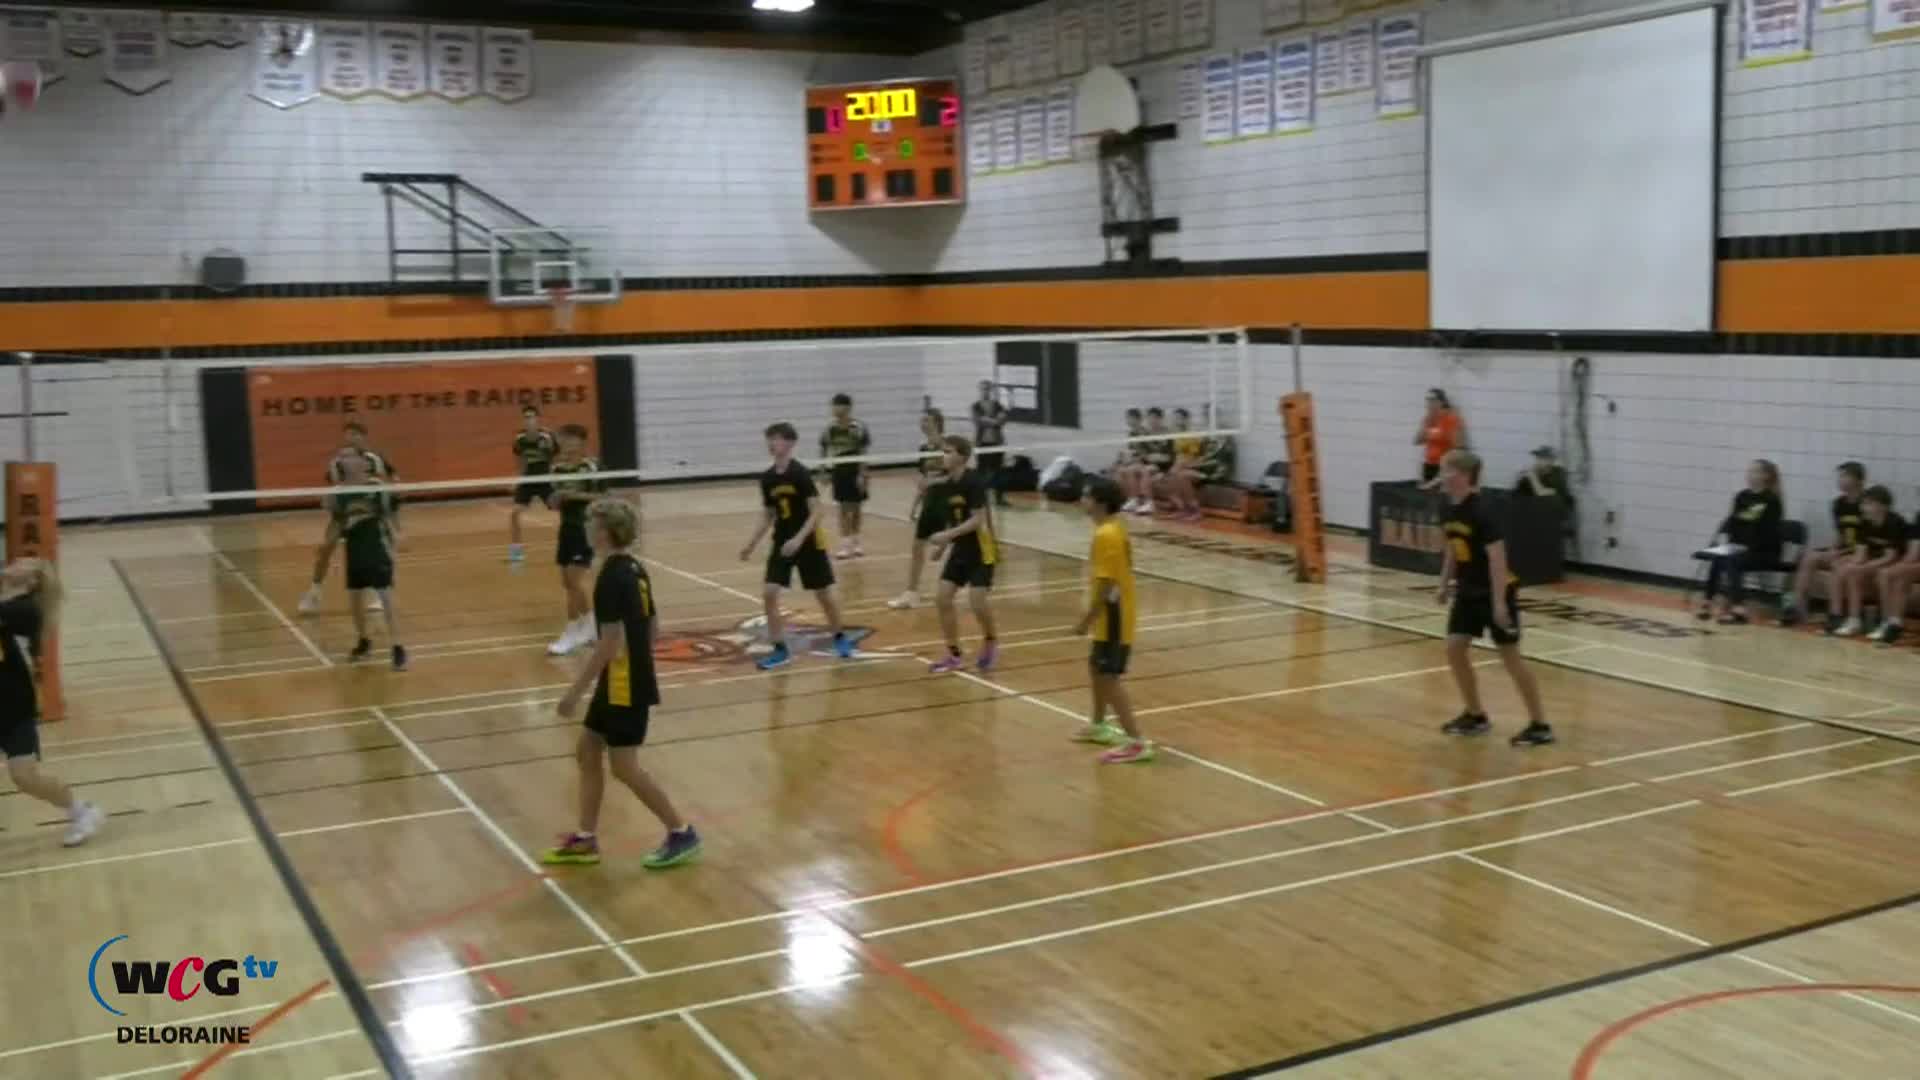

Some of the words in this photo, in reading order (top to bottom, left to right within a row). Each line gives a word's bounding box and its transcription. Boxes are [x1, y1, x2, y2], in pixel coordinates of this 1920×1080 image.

[261, 395, 357, 416] HOME
[367, 393, 400, 411] OF
[408, 391, 457, 409] THE
[464, 385, 587, 408] RAIDERS
